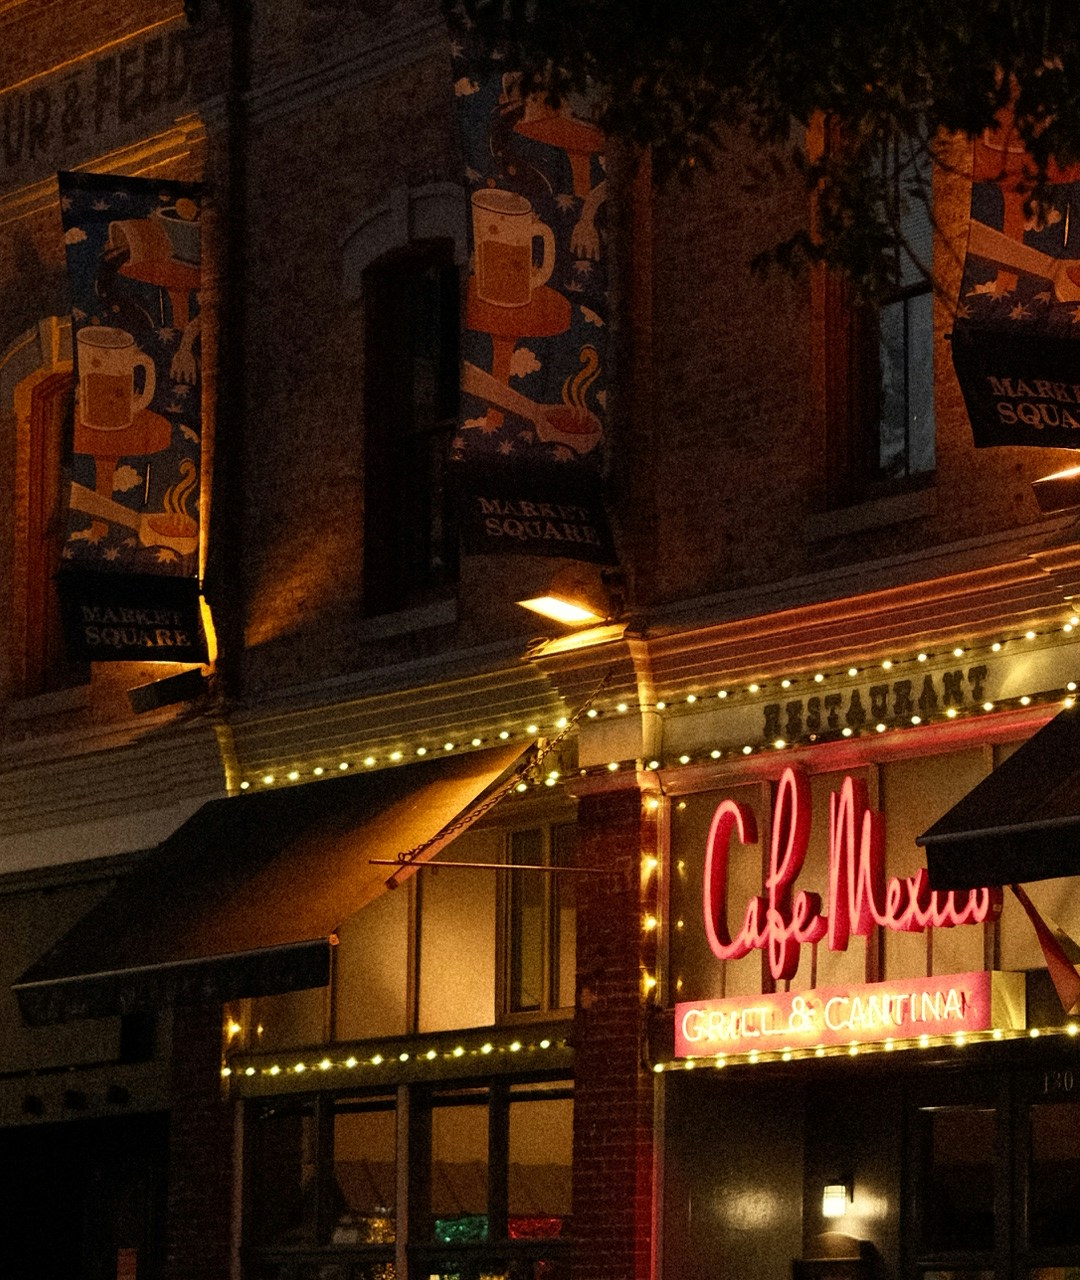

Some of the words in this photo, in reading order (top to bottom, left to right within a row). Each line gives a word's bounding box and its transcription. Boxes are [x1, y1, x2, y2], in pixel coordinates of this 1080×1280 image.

[95, 32, 191, 135] FEED
[477, 496, 590, 521] MARKET
[485, 519, 601, 547] SQUARE
[81, 603, 182, 627] MARKET
[83, 624, 192, 650] SQUARE
[763, 664, 988, 739] RESTAURANT
[703, 766, 827, 980] Cafe
[824, 988, 964, 1032] CANTINA
